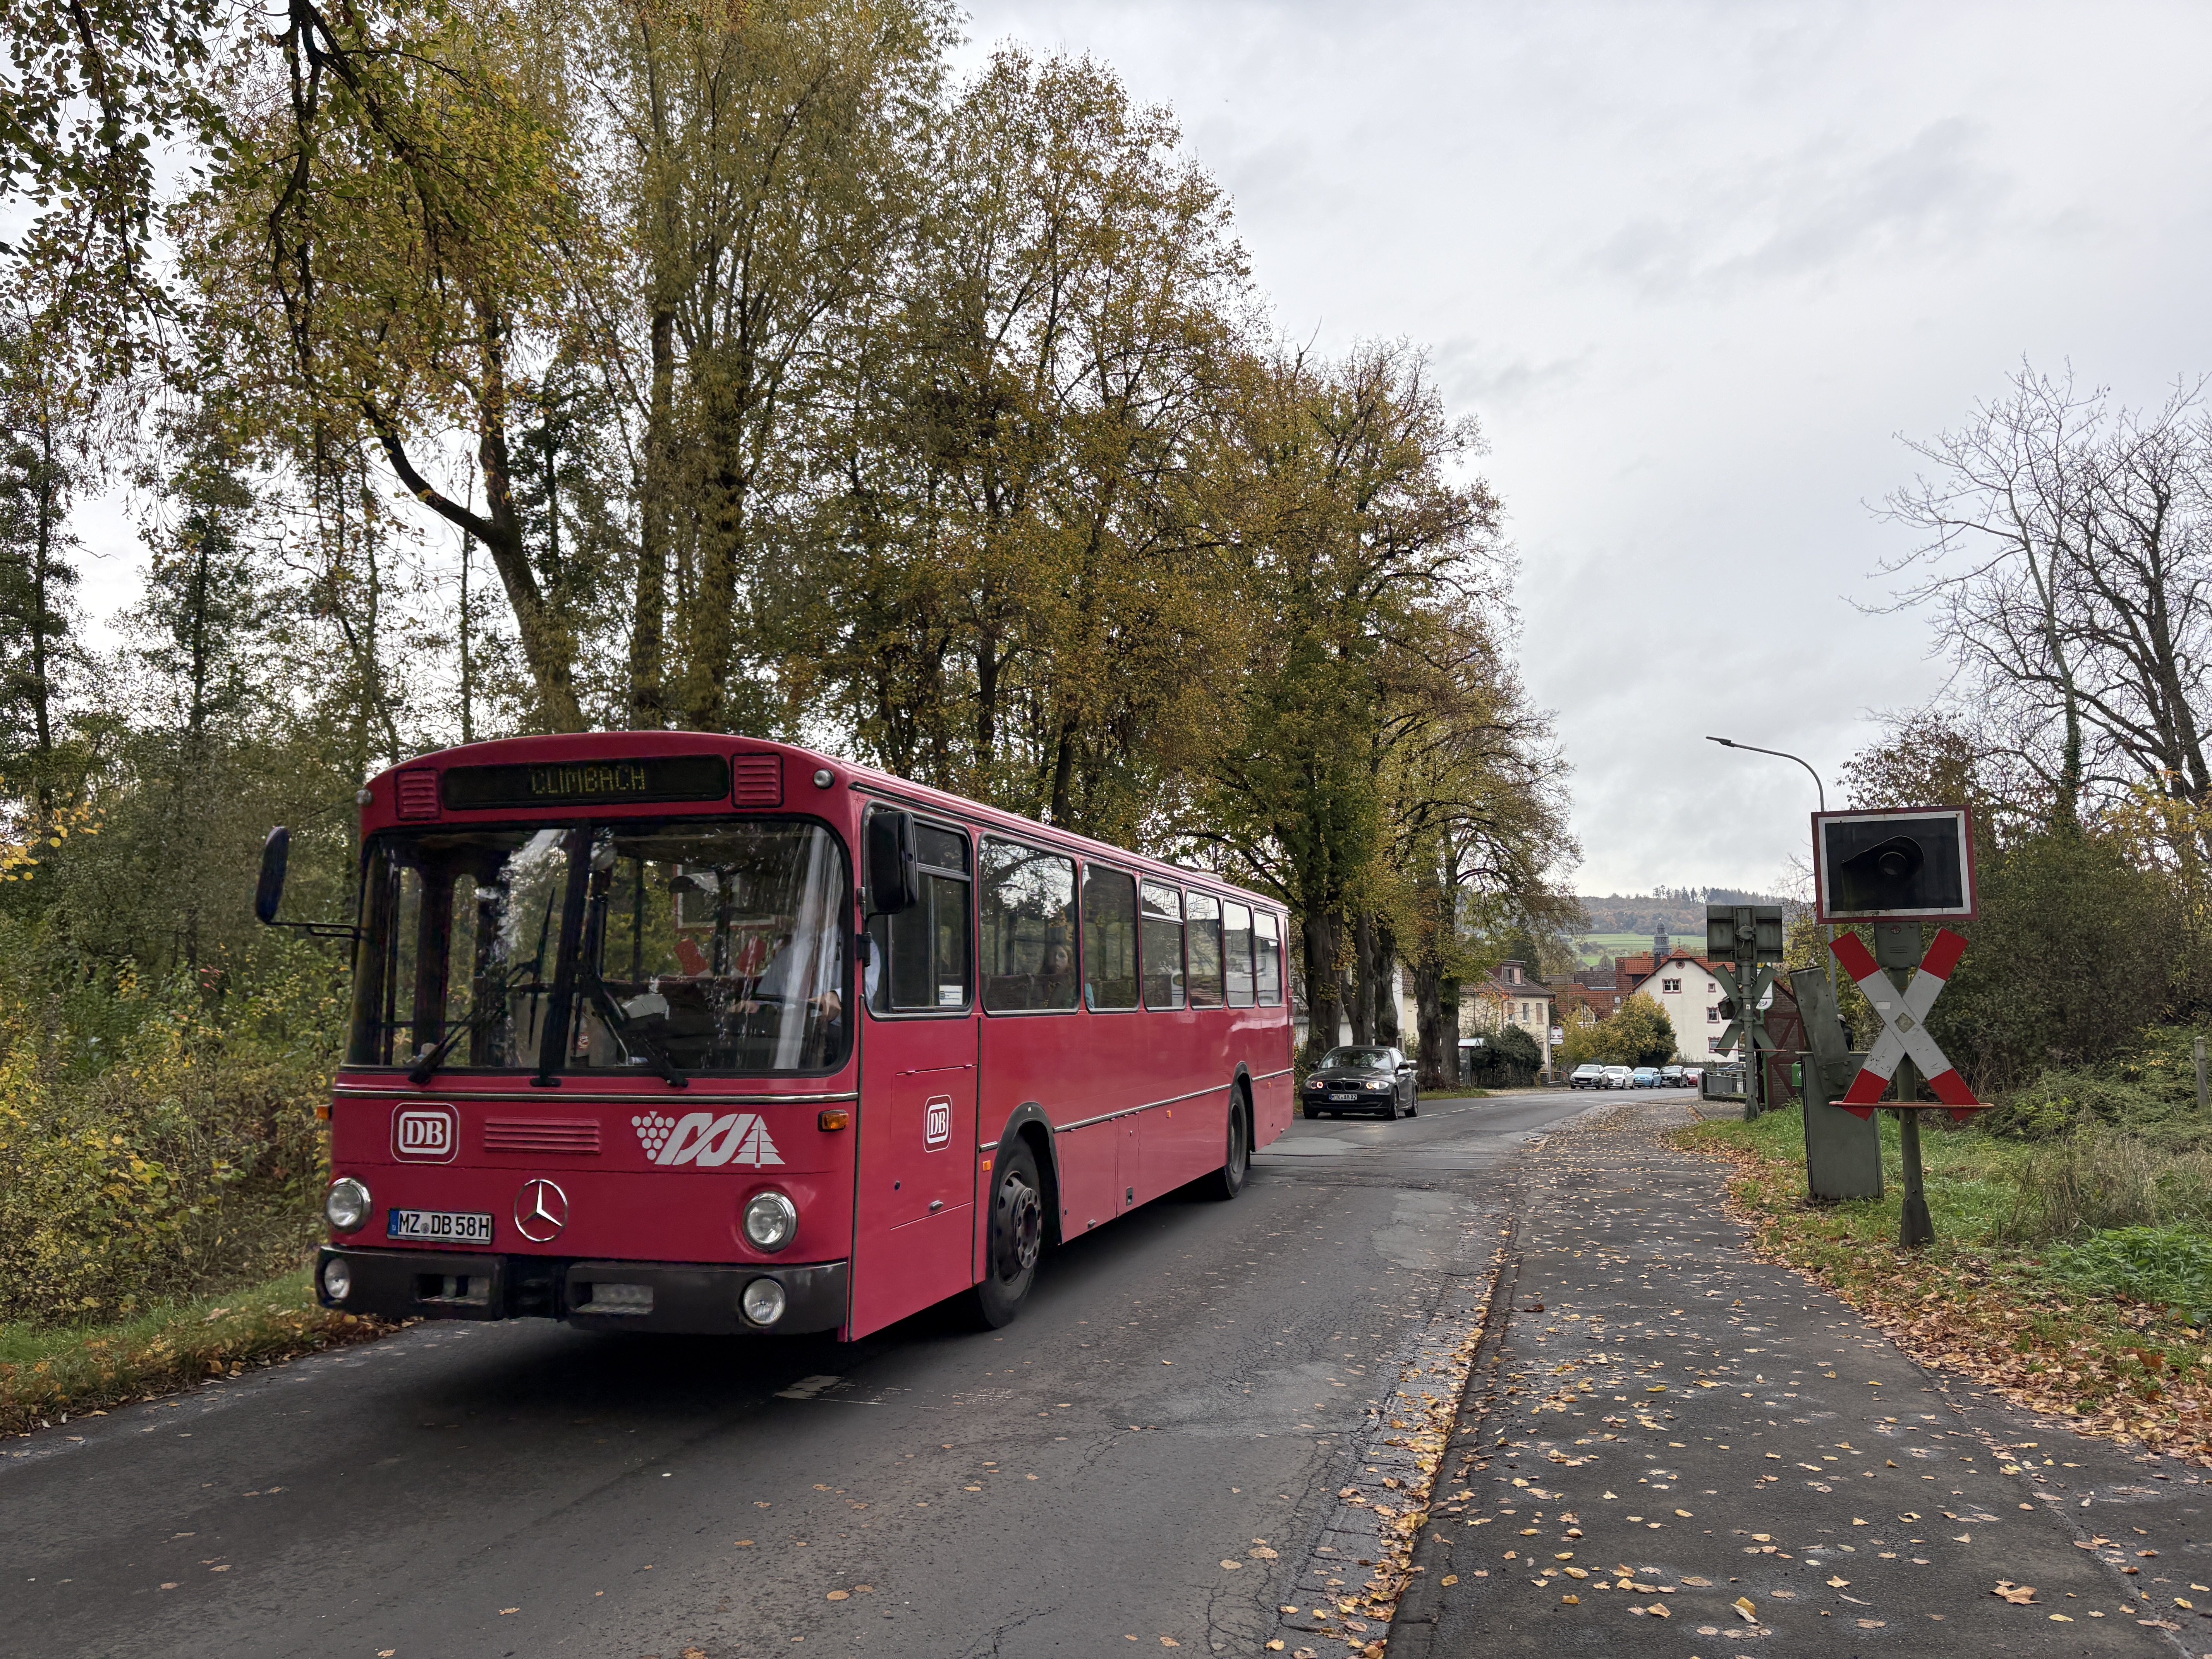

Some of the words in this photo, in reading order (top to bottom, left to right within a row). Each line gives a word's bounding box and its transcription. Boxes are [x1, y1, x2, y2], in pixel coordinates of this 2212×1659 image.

[531, 765, 645, 793] CLIMBACH
[404, 1120, 443, 1145] DB
[929, 1111, 946, 1135] DB
[399, 1213, 420, 1233] MZ
[431, 1215, 452, 1235] DB
[455, 1216, 489, 1237] 58H
